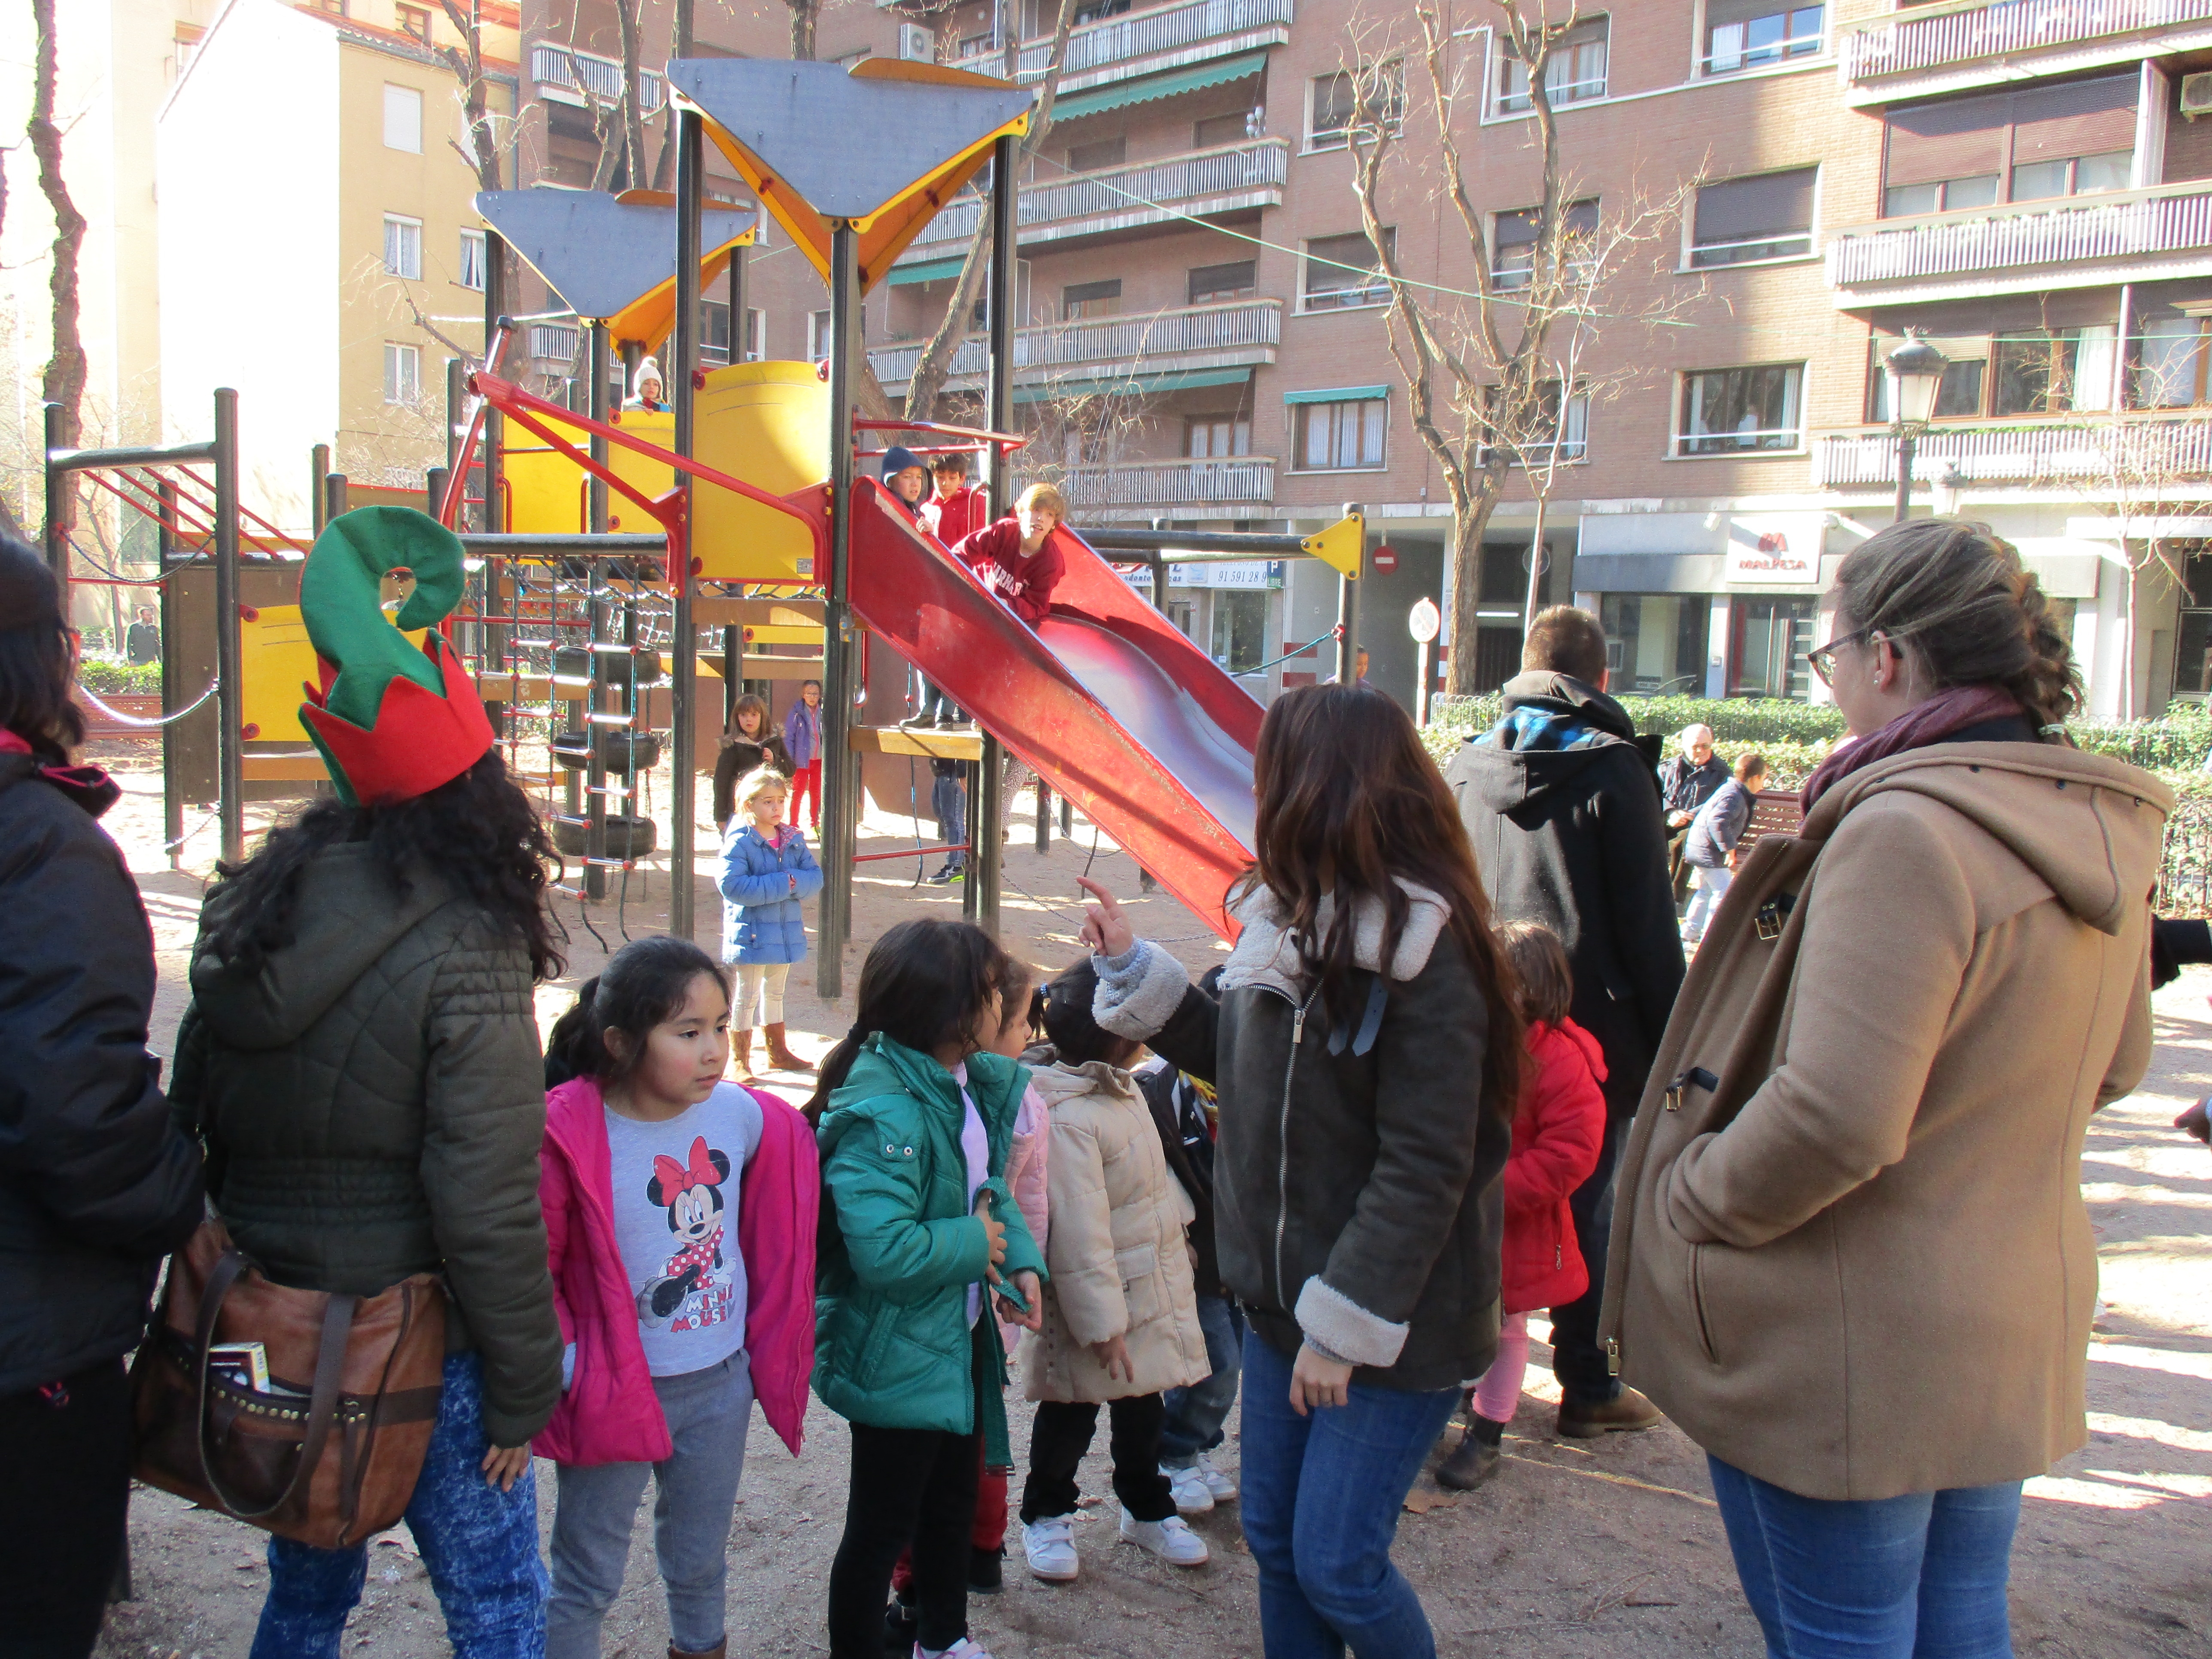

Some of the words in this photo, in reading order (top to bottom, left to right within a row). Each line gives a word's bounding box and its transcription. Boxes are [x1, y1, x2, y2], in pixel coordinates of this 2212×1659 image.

[1271, 561, 1278, 573] P
[1739, 559, 1808, 570] MALPESA
[1218, 571, 1228, 582] 91
[1231, 571, 1245, 582] 591
[1249, 571, 1259, 582] 28
[1261, 571, 1267, 583] 9
[1268, 577, 1281, 586] LIBRE
[685, 1283, 733, 1313] MINNIE
[670, 1305, 727, 1333] MOUSE
